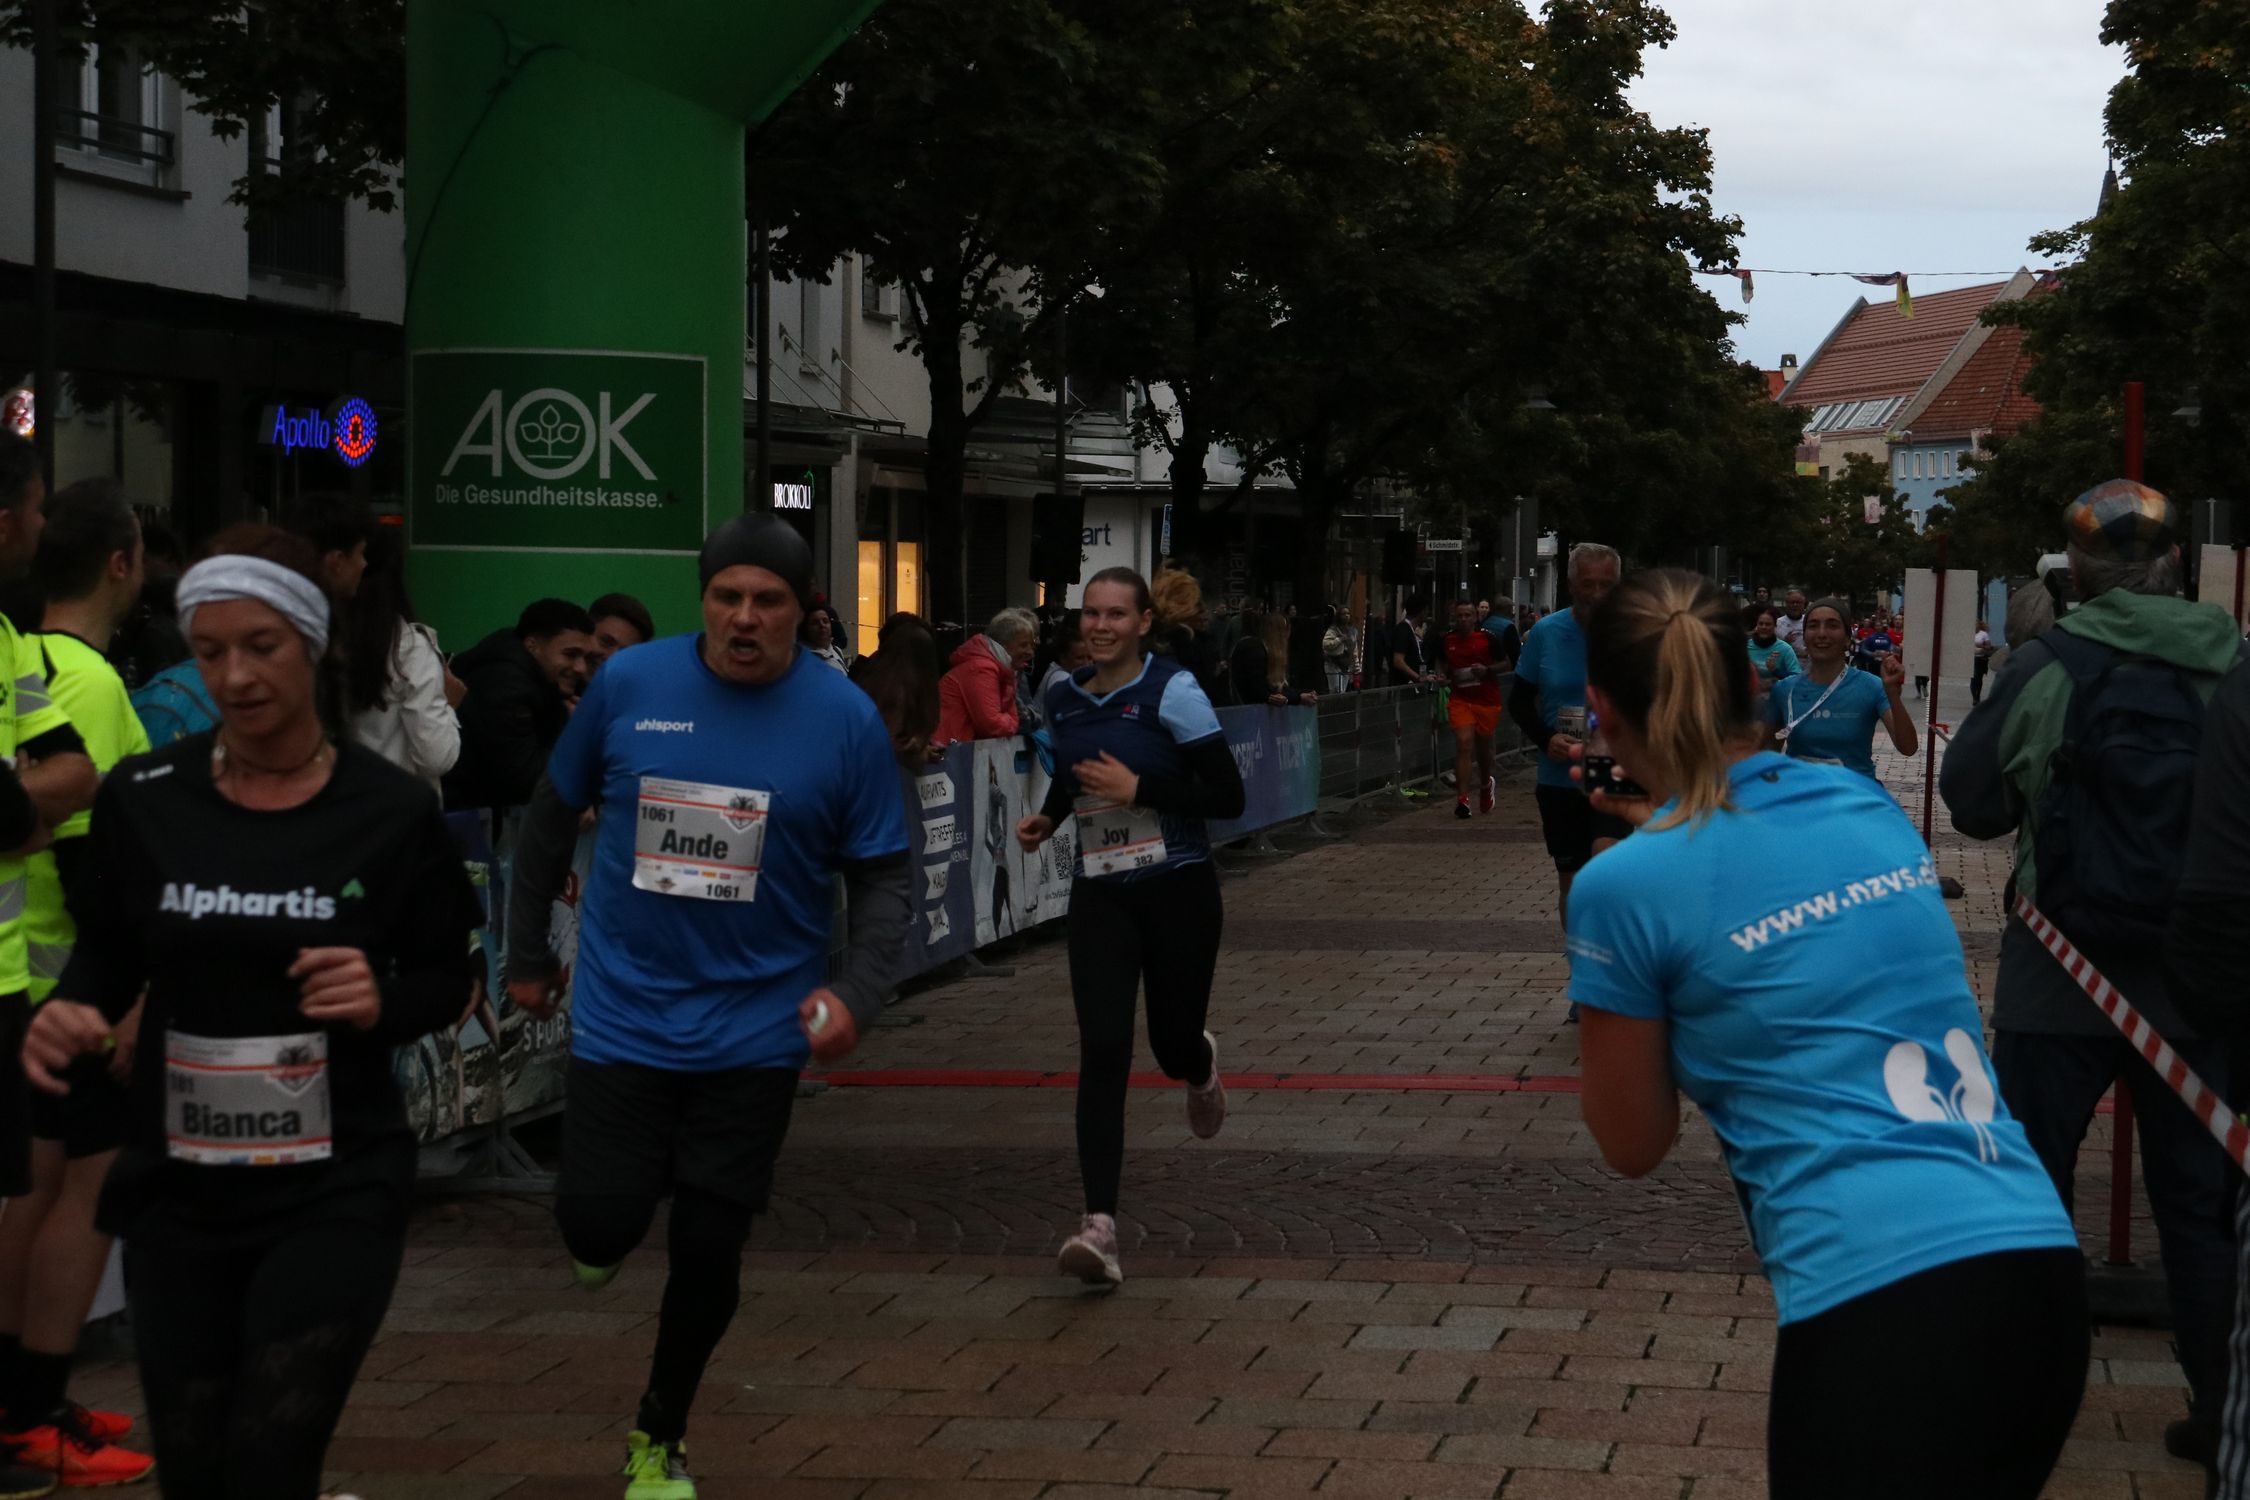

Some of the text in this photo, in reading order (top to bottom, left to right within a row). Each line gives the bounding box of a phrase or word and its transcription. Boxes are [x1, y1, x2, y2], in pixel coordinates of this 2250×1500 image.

[272, 403, 331, 456] Apollo
[440, 387, 658, 480] AOK
[435, 483, 663, 508] Die Gesundheitskasse.
[774, 483, 812, 510] BROKKOLI
[635, 719, 694, 733] uhlsport
[641, 805, 675, 823] 1061
[660, 828, 728, 859] Ande
[1102, 827, 1130, 845] Joy
[1134, 854, 1153, 867] 382
[158, 882, 337, 921] Alphartis
[706, 883, 740, 898] 1061
[182, 1102, 302, 1138] Bianca
